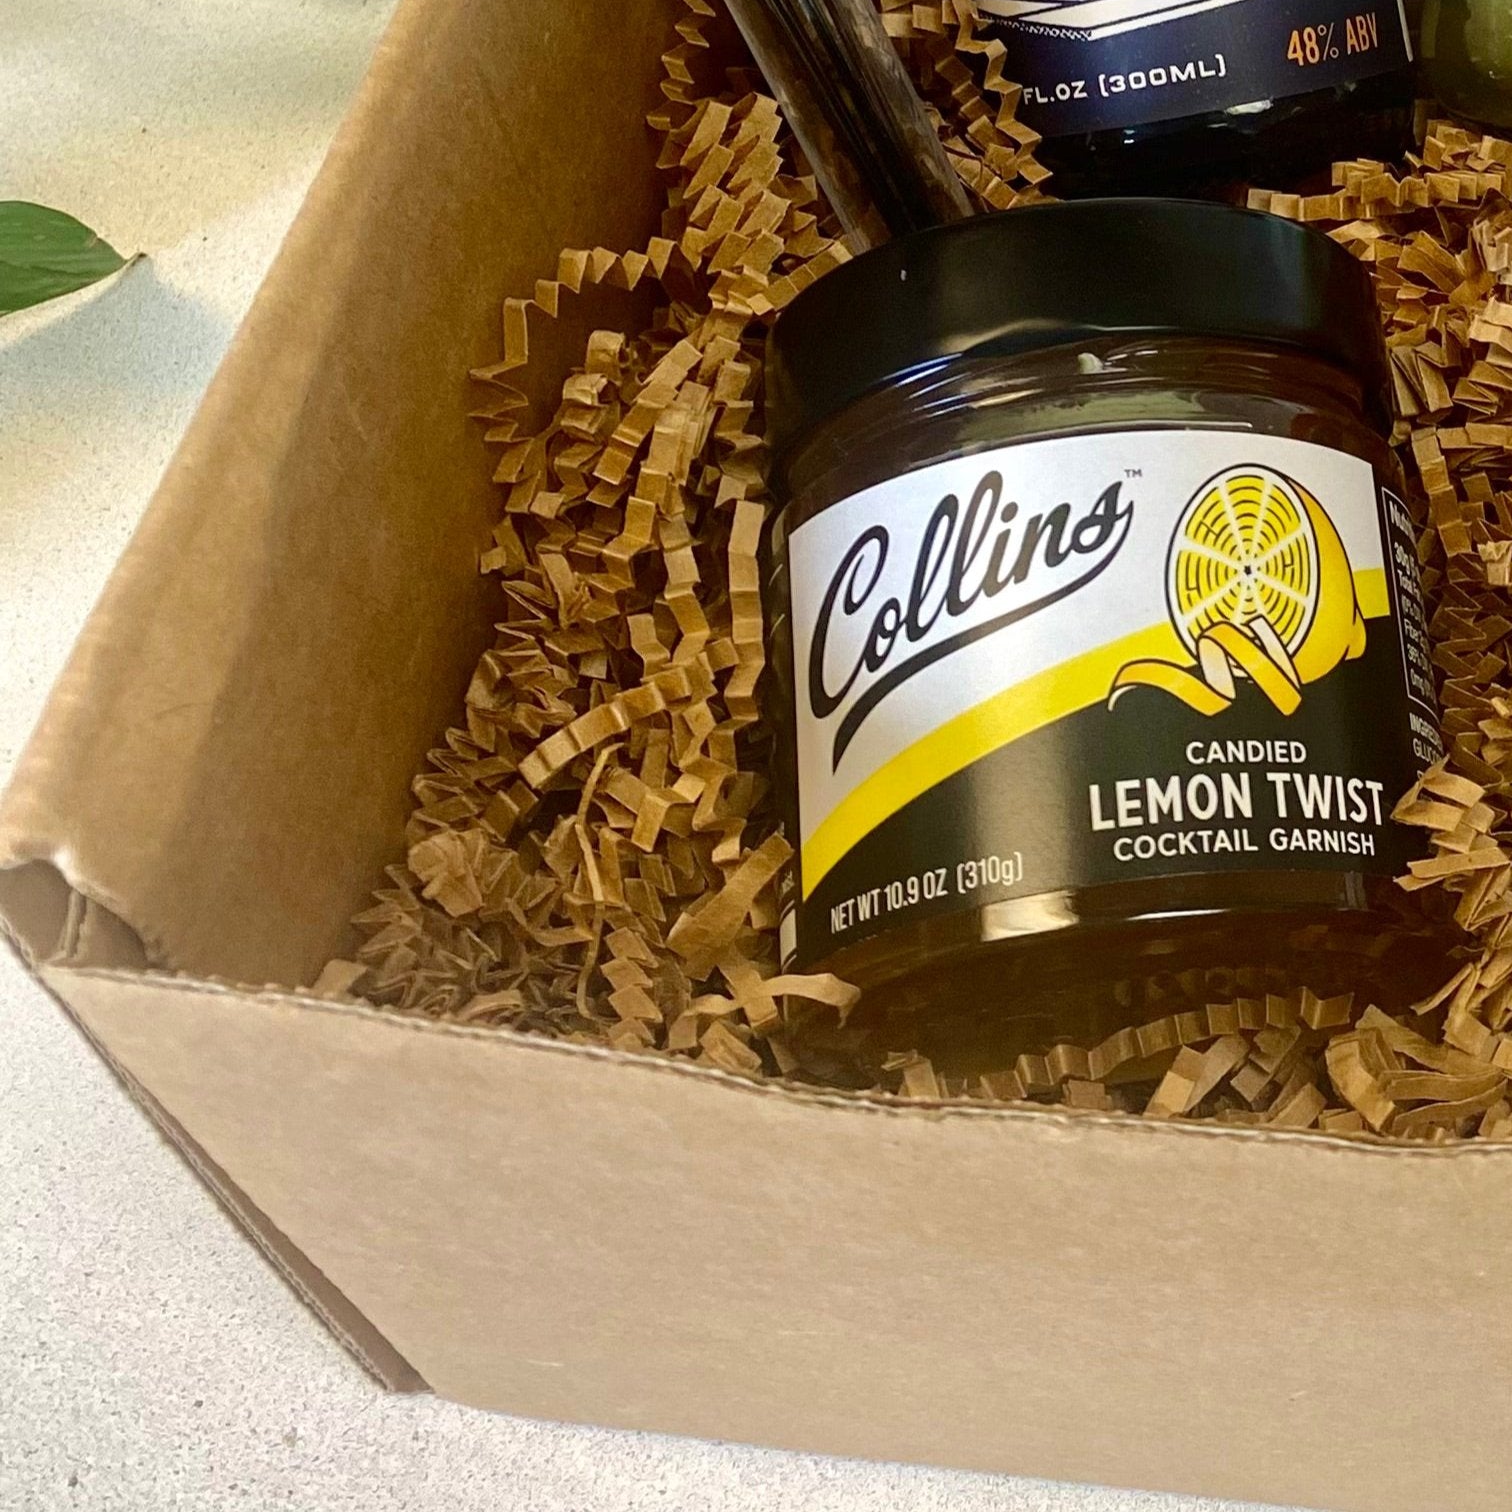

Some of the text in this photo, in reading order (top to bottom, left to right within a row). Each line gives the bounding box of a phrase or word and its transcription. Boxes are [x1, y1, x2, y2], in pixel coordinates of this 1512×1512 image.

[1286, 12, 1379, 67] 48% ABV
[808, 469, 1135, 776] Collins
[1185, 740, 1307, 765] CANDIED
[1089, 772, 1384, 831] LEMON TWIST
[1113, 828, 1375, 862] COCKTAIL GARNISH
[830, 851, 1024, 934] NET WT 10.9 OZ (310g)
